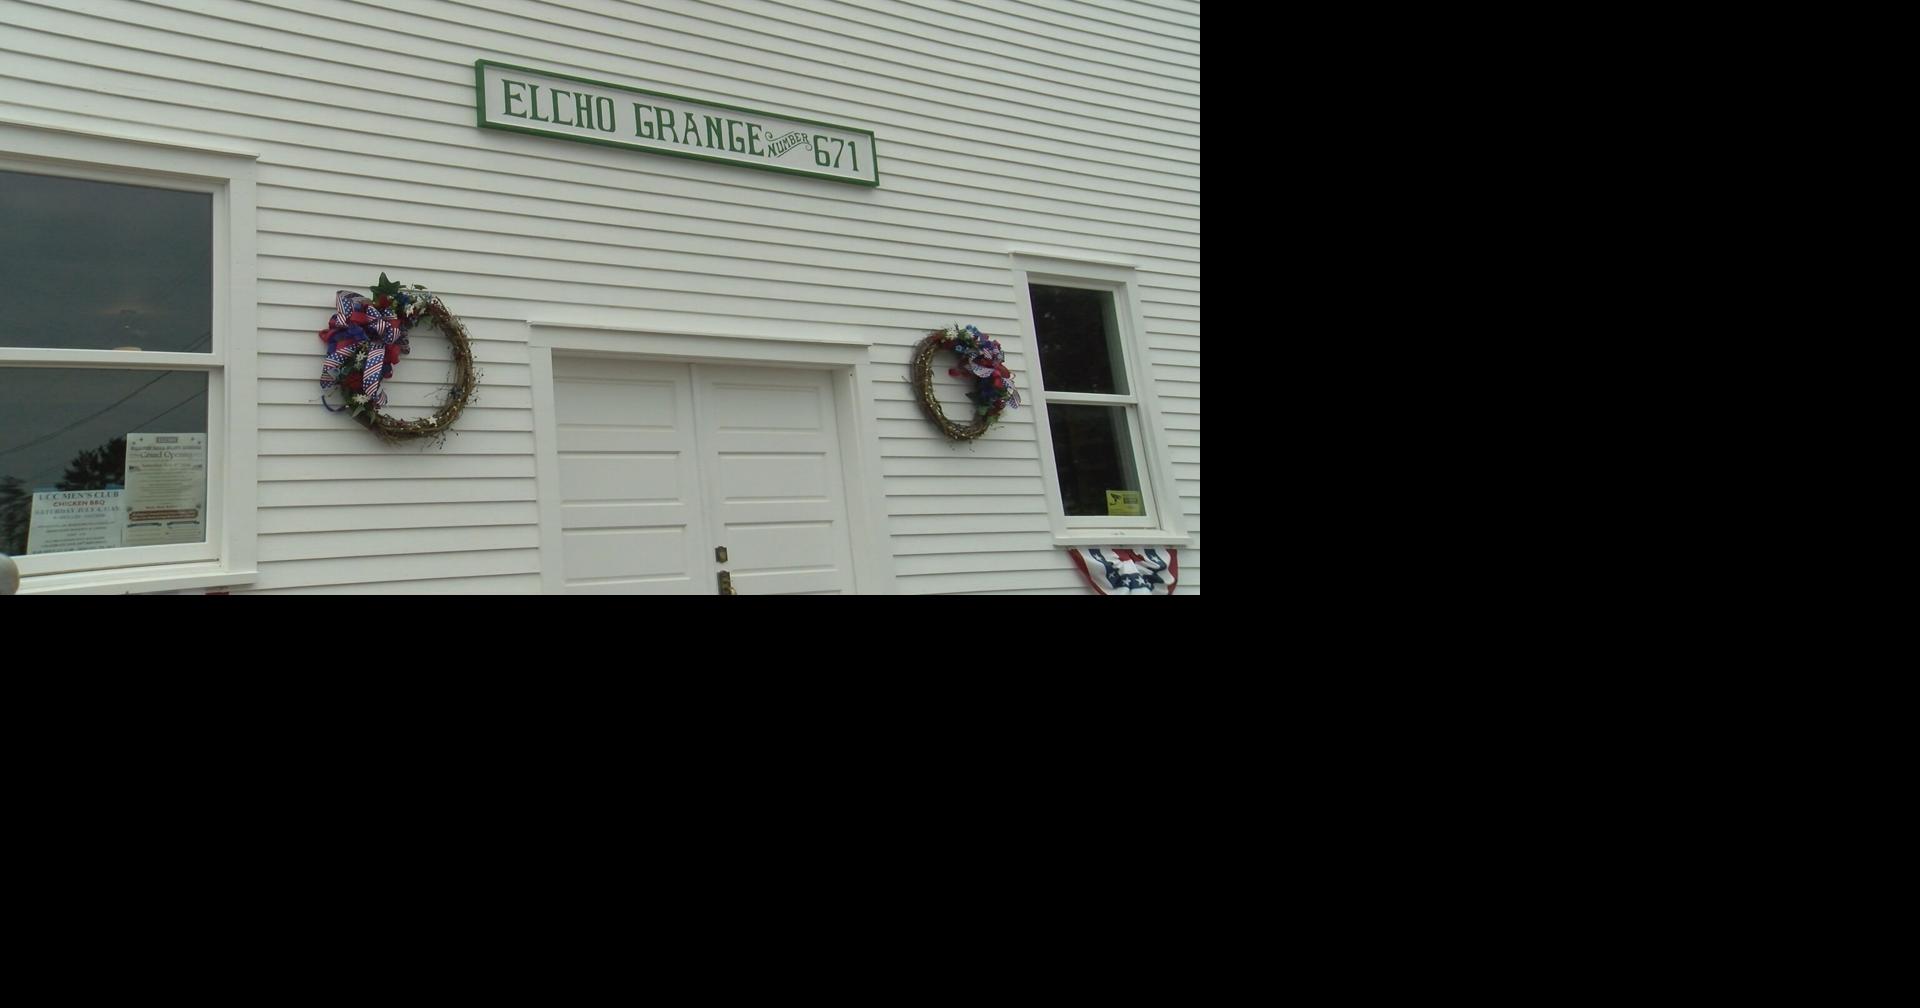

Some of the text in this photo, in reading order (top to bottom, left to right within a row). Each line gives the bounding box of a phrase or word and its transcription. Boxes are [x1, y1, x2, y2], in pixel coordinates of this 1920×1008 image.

[501, 79, 860, 172] ELCHO GRANGE NUMBER 671
[93, 490, 120, 498] CLUB
